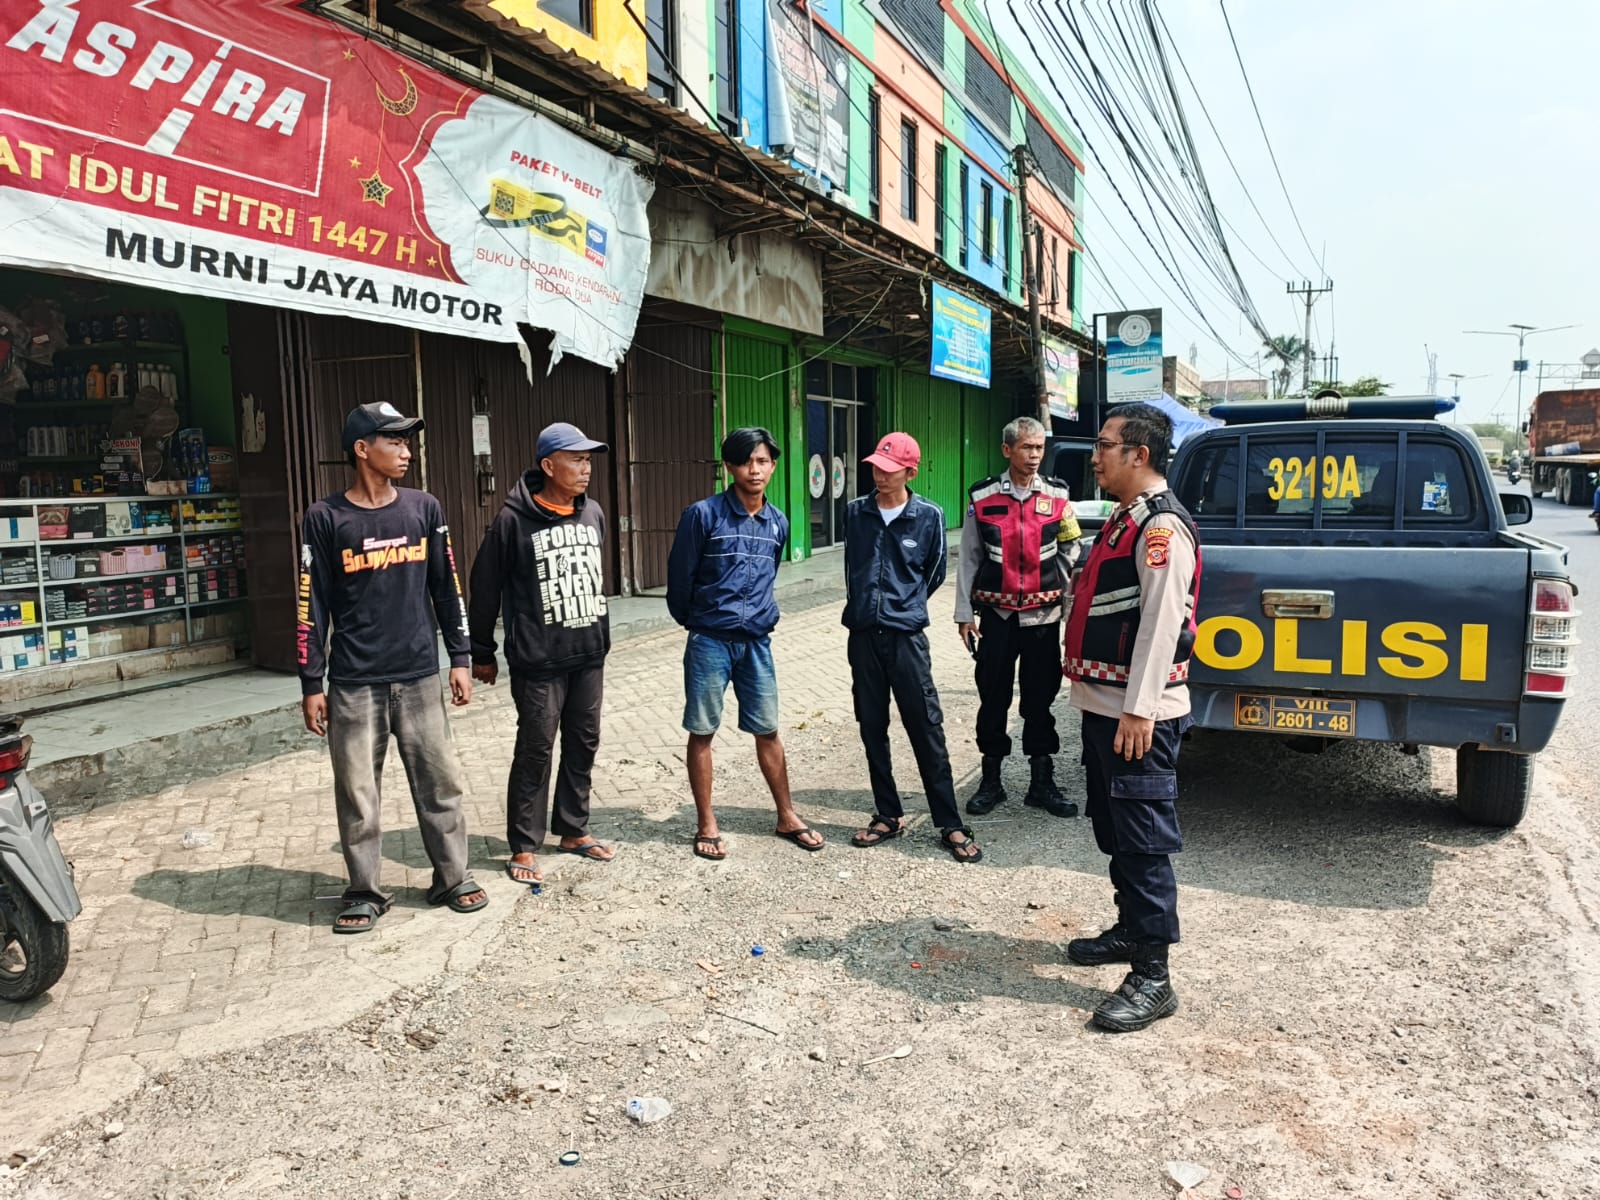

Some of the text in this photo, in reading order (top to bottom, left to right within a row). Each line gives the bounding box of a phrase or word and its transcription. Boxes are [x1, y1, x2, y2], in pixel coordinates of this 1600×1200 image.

[510, 150, 603, 199] PAKET V-BELT
[69, 153, 180, 211] IDUL
[192, 184, 296, 237] FITRI
[308, 215, 389, 257] 1447
[395, 235, 418, 265] H
[476, 248, 514, 267] SUKU
[106, 228, 503, 326] MURNI JAYA MOTOR
[535, 278, 572, 297] RODA
[1267, 455, 1361, 501] 3219A
[540, 523, 599, 551] FORGO
[548, 573, 604, 601] EVERY
[551, 594, 607, 623] THING
[1194, 615, 1489, 682] OLISI
[1276, 711, 1313, 729] 2601
[1328, 715, 1349, 731] 48
